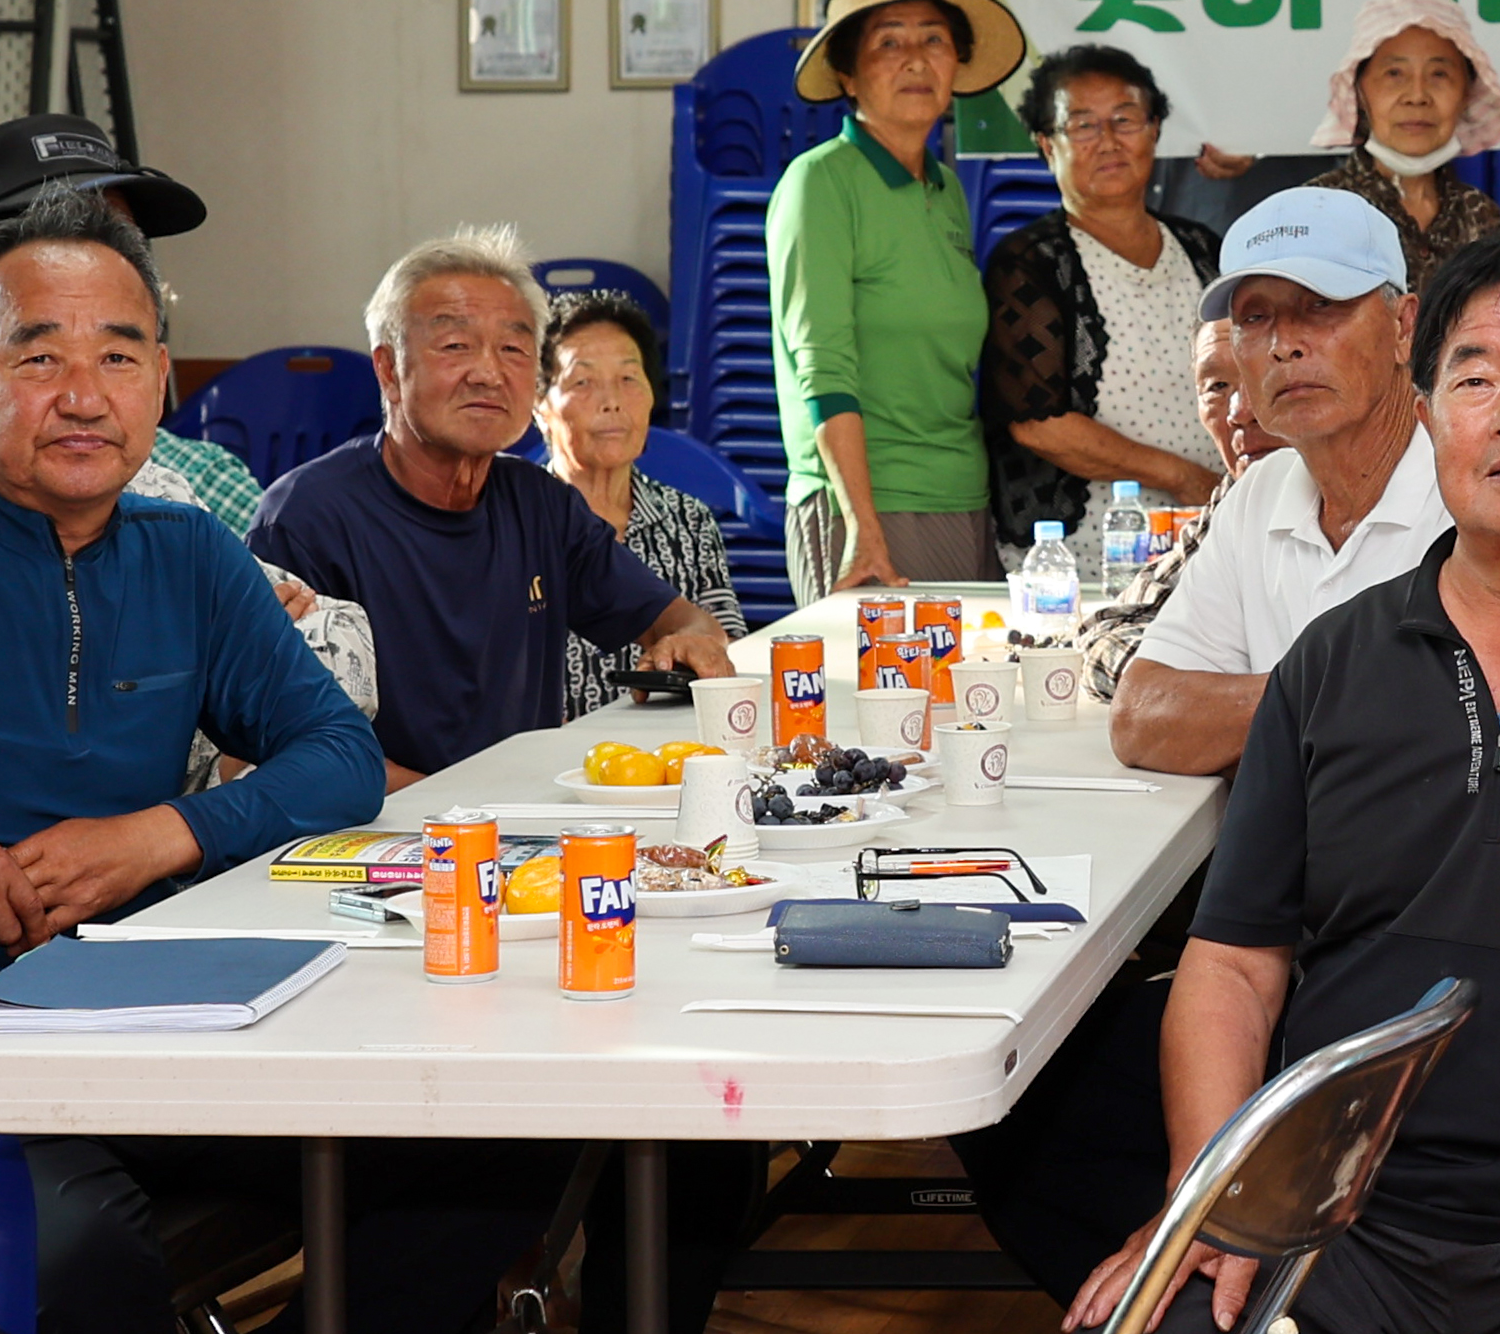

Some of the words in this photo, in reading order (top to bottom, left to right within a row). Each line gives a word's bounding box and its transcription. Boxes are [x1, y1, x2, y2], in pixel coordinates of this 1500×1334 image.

[66, 590, 82, 665] WORKING
[67, 671, 78, 706] MAN
[1454, 649, 1477, 702] NEPA
[1464, 700, 1484, 746] EXTREME
[1466, 745, 1484, 795] ADVENTURE
